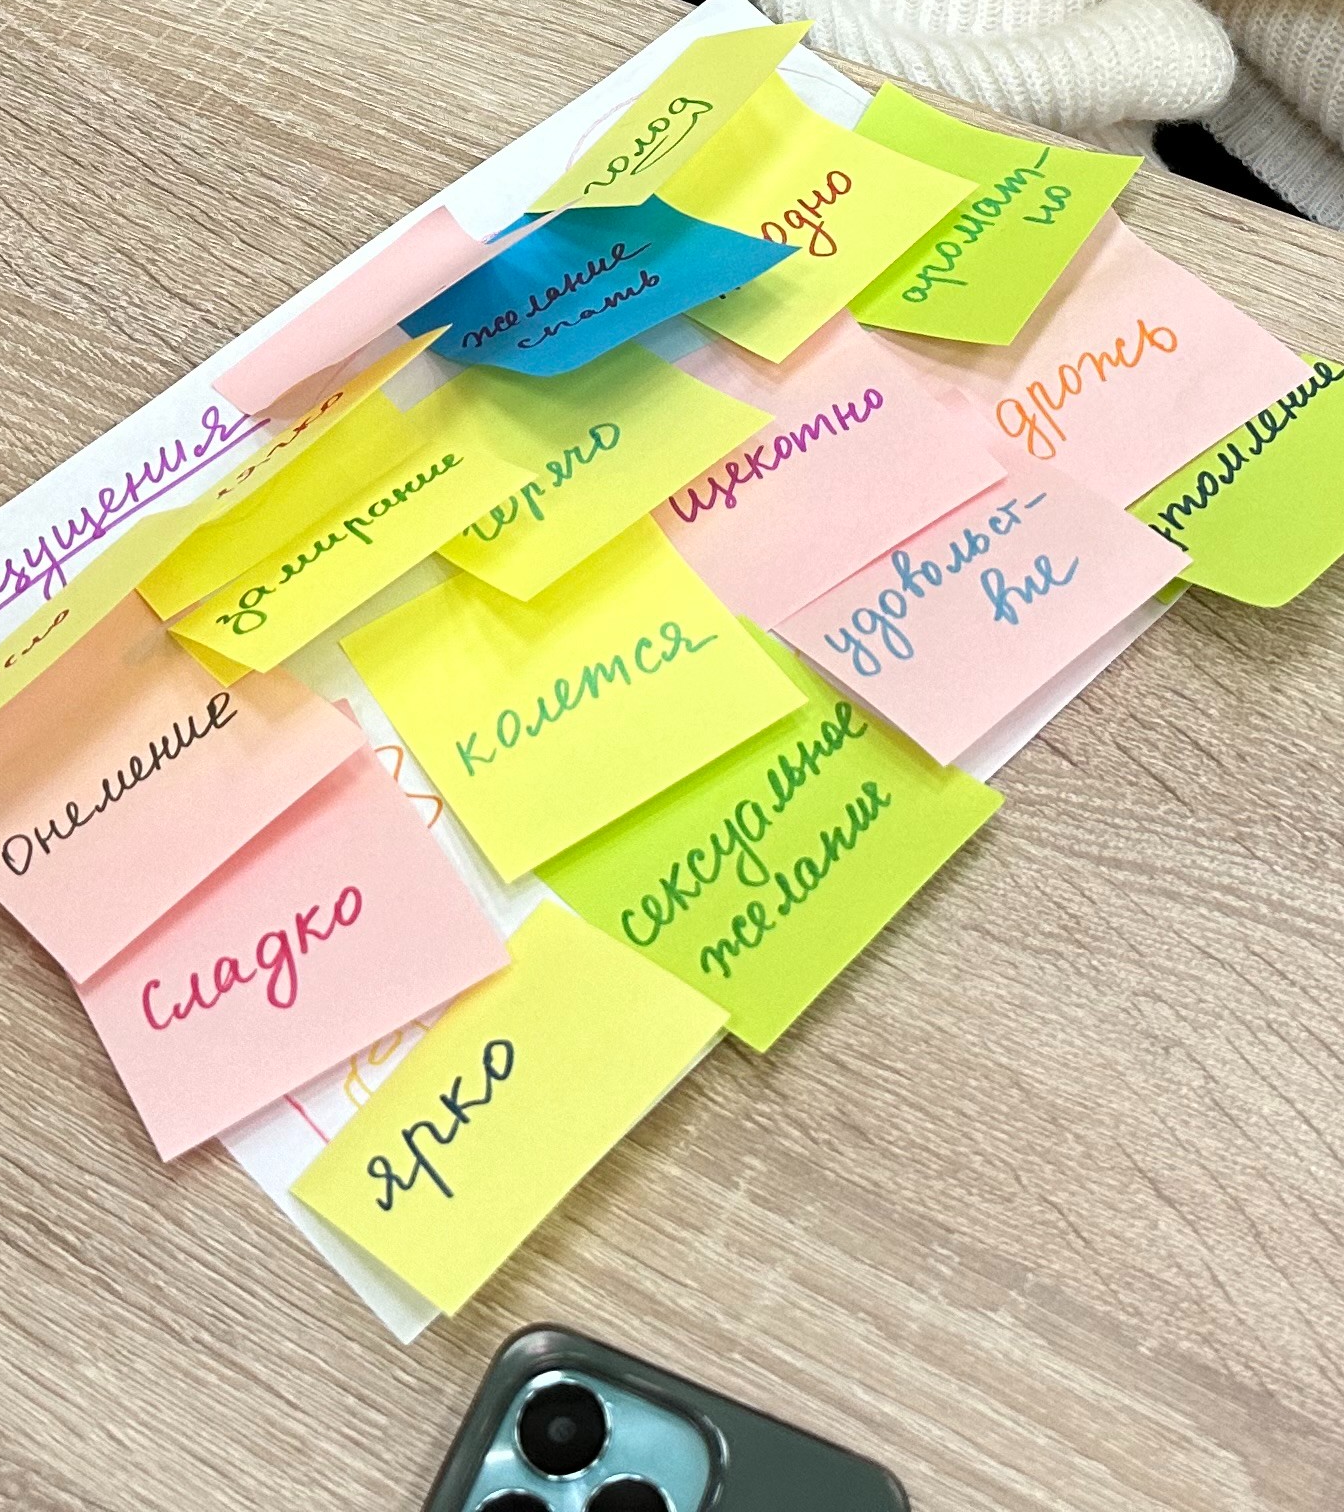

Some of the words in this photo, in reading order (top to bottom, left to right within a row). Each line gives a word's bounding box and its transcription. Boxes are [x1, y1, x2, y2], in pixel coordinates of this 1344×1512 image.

[584, 97, 713, 194] голод
[1022, 185, 1072, 225] но
[461, 243, 652, 348] желание
[517, 270, 660, 349] спать
[668, 386, 885, 523] щекотно
[996, 319, 1178, 460] дрожь
[216, 452, 464, 636] замирание
[980, 553, 1080, 626] вие
[455, 621, 719, 777] колется
[1, 691, 238, 876] онемение
[621, 700, 868, 947] сексуальное
[366, 1038, 515, 1211] ярко
